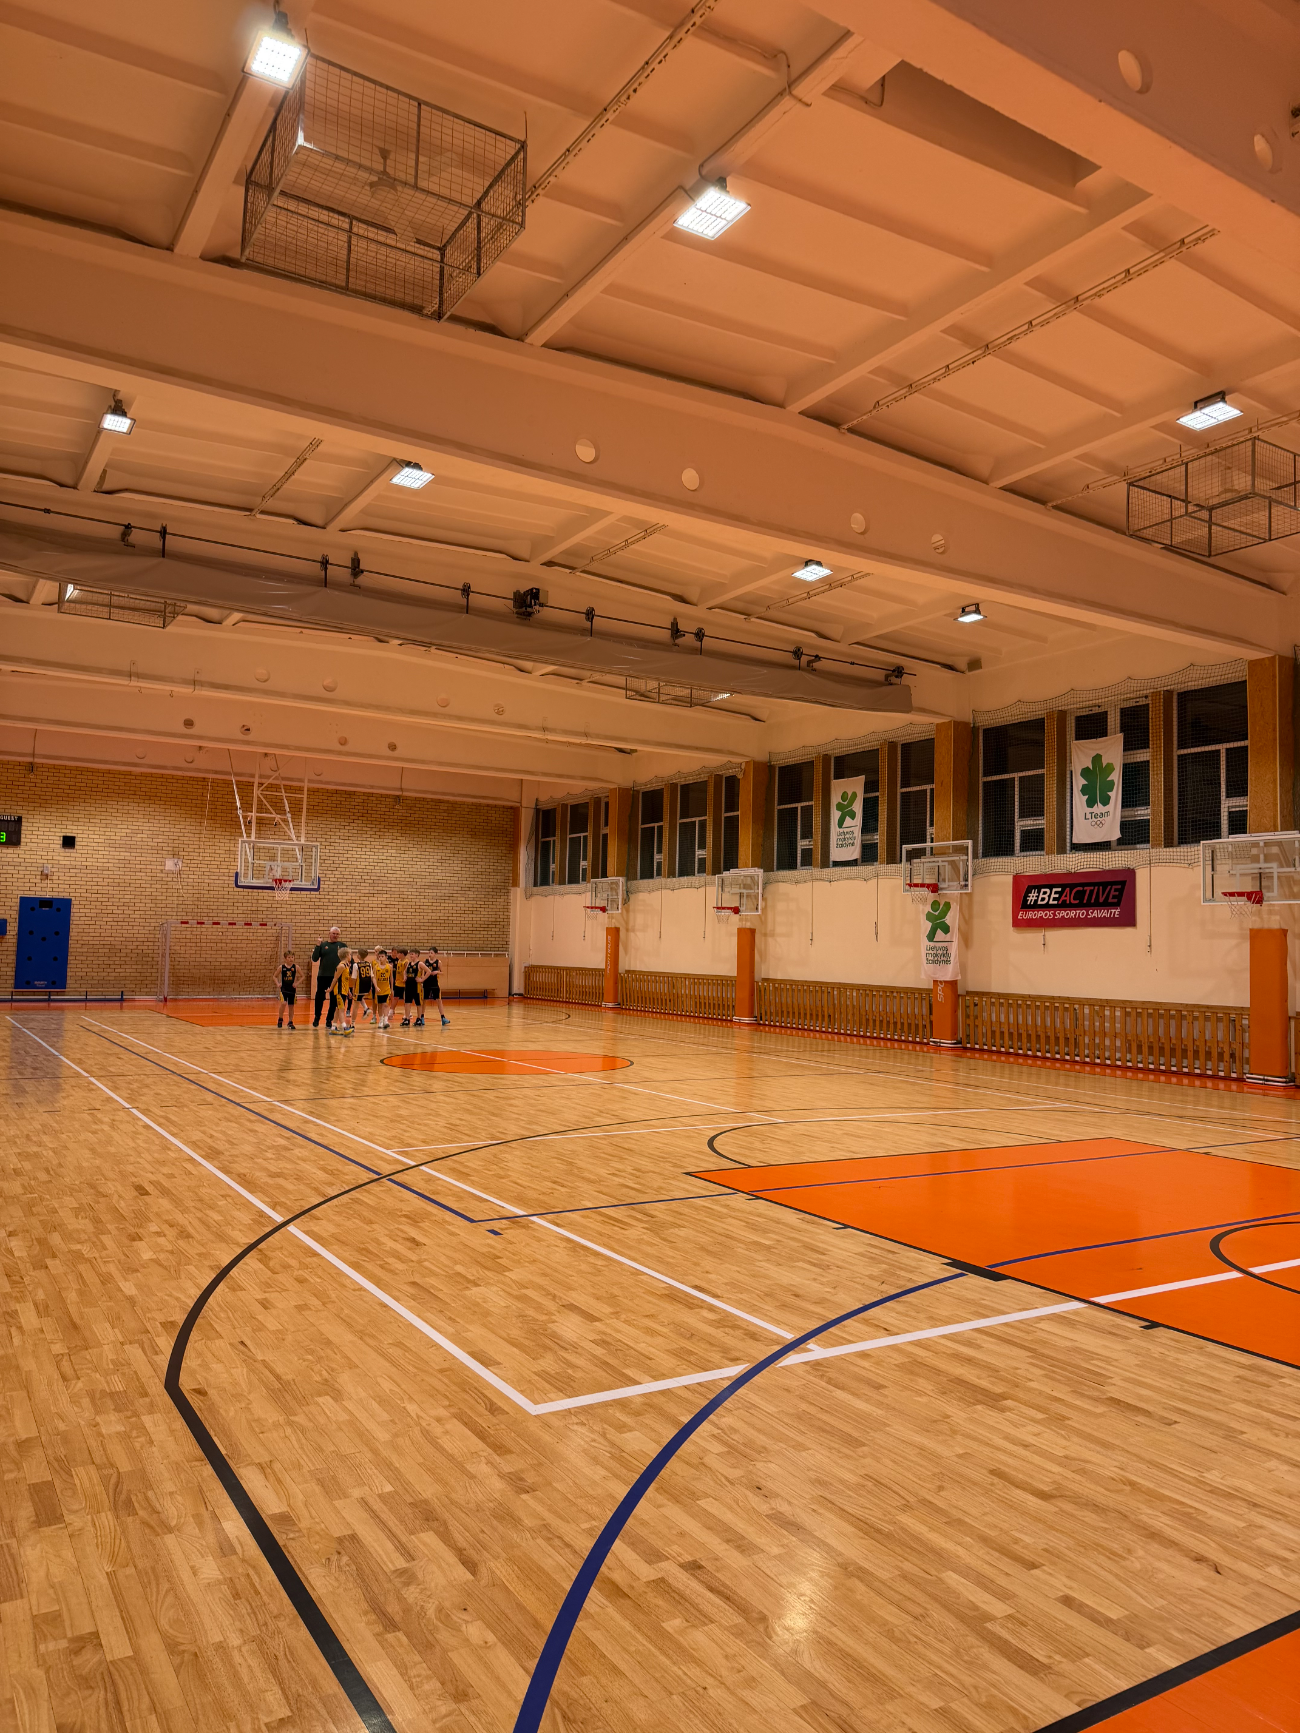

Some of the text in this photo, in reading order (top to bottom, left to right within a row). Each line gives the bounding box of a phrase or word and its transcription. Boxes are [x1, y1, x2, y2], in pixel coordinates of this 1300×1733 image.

[1084, 811, 1110, 820] LTeam
[1026, 885, 1121, 905] #BEACTIVE
[1018, 907, 1121, 919] EUROPOS SPORTO SAVAITĖ
[360, 966, 370, 977] 99
